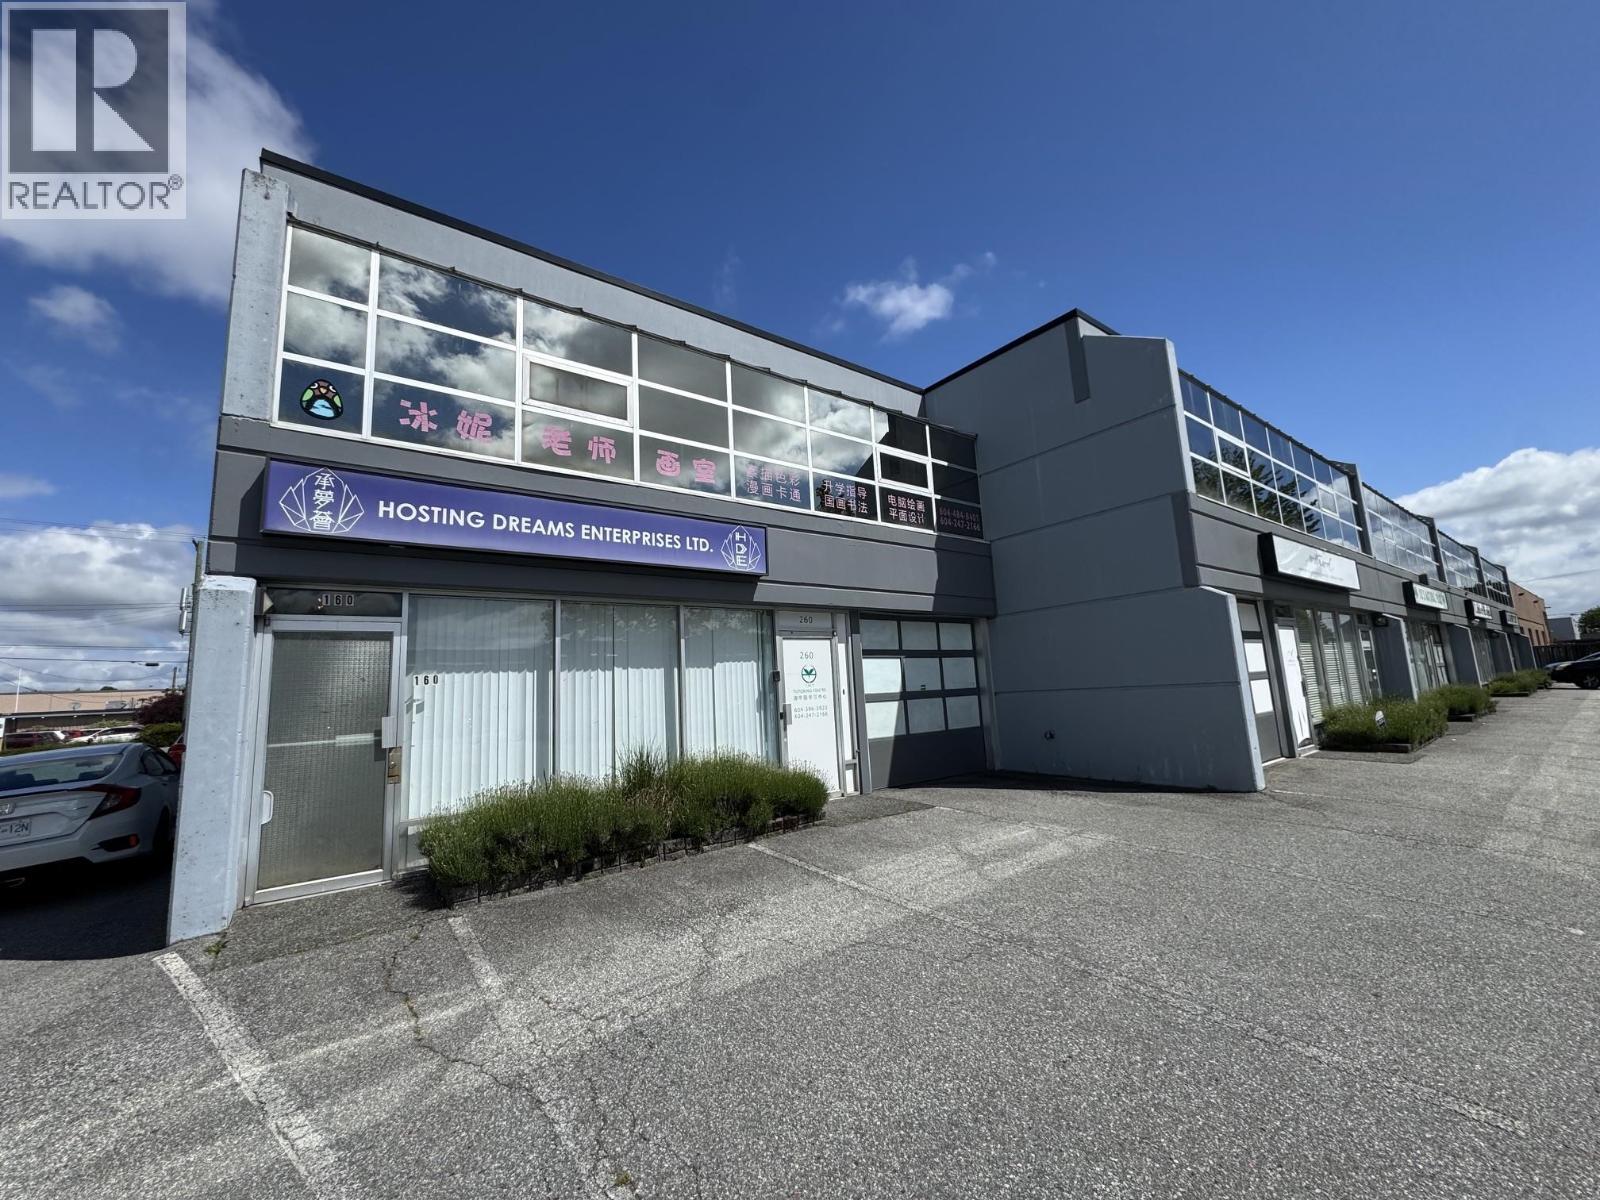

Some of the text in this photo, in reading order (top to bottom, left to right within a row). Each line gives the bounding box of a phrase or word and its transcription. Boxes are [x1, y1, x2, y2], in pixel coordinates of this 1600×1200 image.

[399, 399, 717, 484] 冰妮老师画室
[745, 479, 802, 502] 漫画卡通
[823, 480, 868, 499] 升学指导
[824, 494, 869, 514] 国画书法
[888, 507, 925, 524] 平面设计
[377, 500, 714, 553] HOSTING DREAMS ENTERPRISES LTD.
[735, 531, 748, 567] HDE
[323, 594, 354, 606] 160
[799, 616, 813, 624] 260
[799, 651, 814, 660] 260
[414, 674, 439, 686] 160
